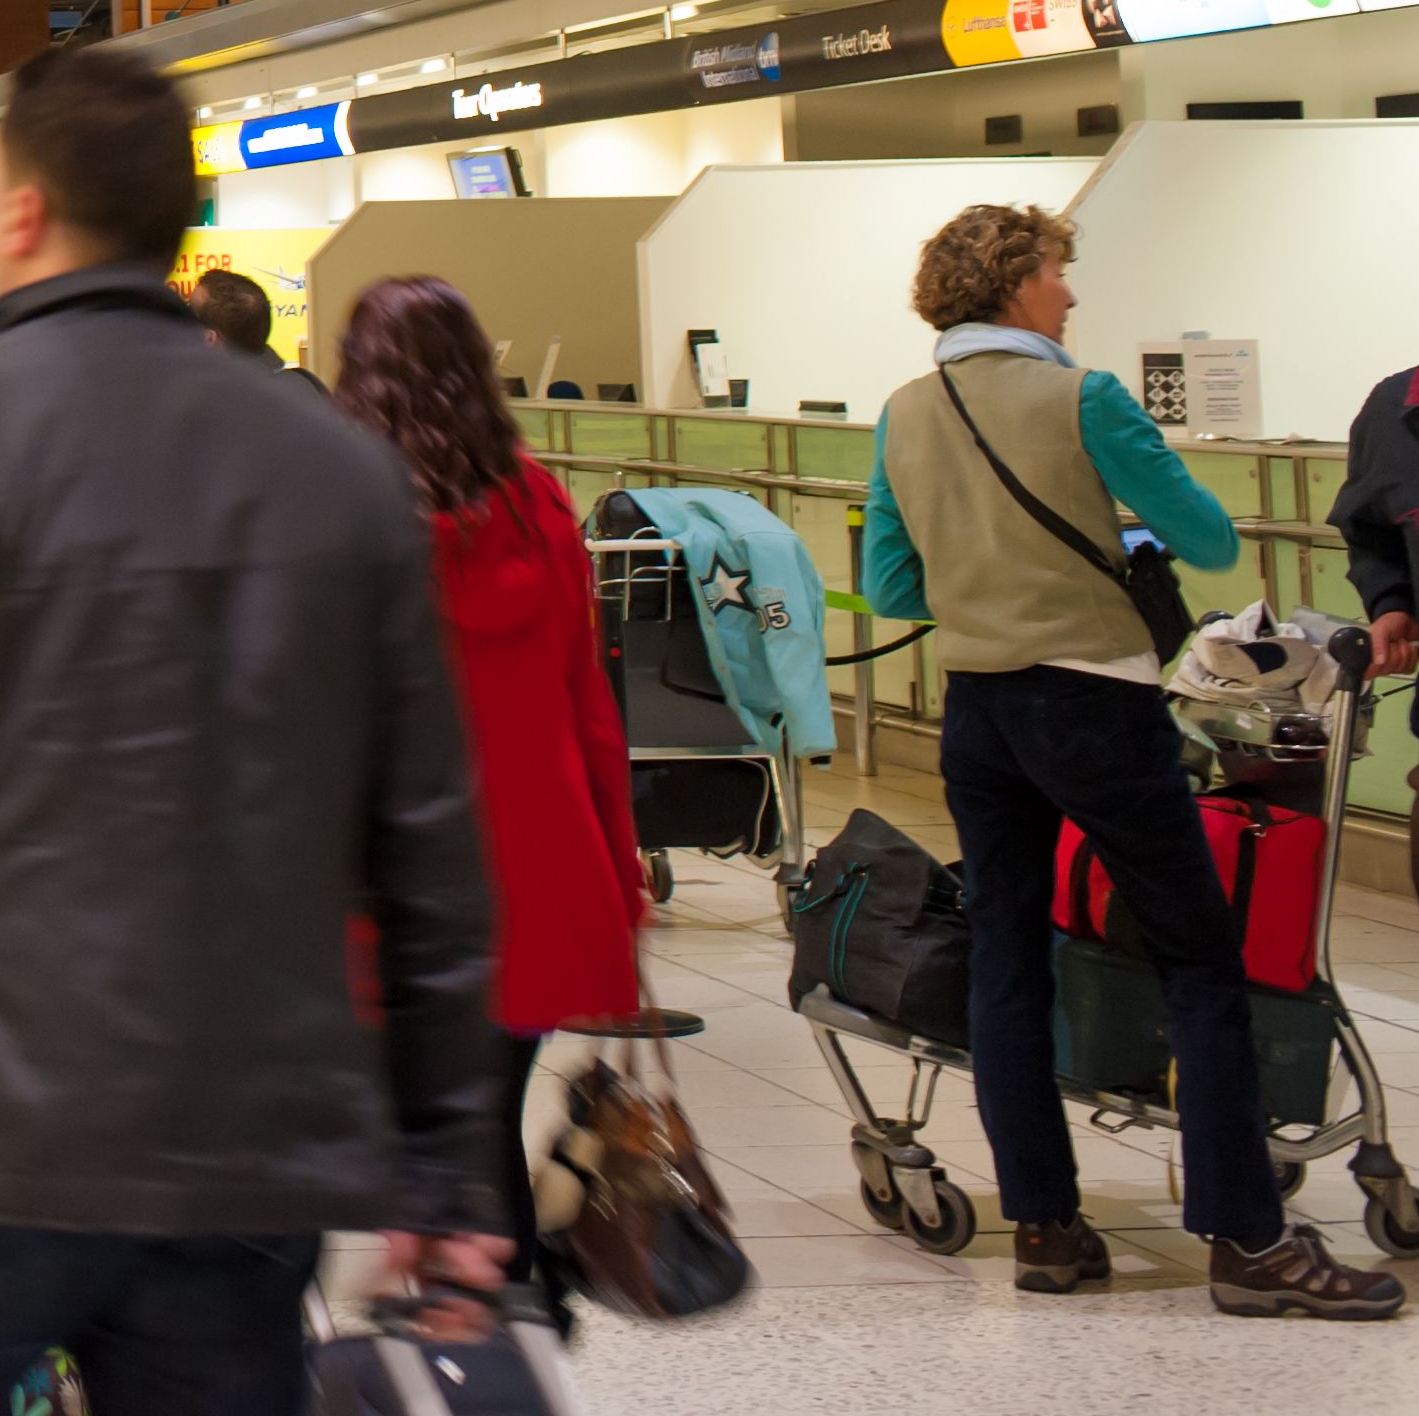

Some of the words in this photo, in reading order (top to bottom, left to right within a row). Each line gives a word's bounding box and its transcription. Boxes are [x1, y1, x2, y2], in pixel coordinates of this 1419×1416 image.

[822, 35, 858, 60] Ticket
[861, 25, 892, 54] Desk
[692, 48, 720, 69] British
[195, 253, 232, 272] FOR
